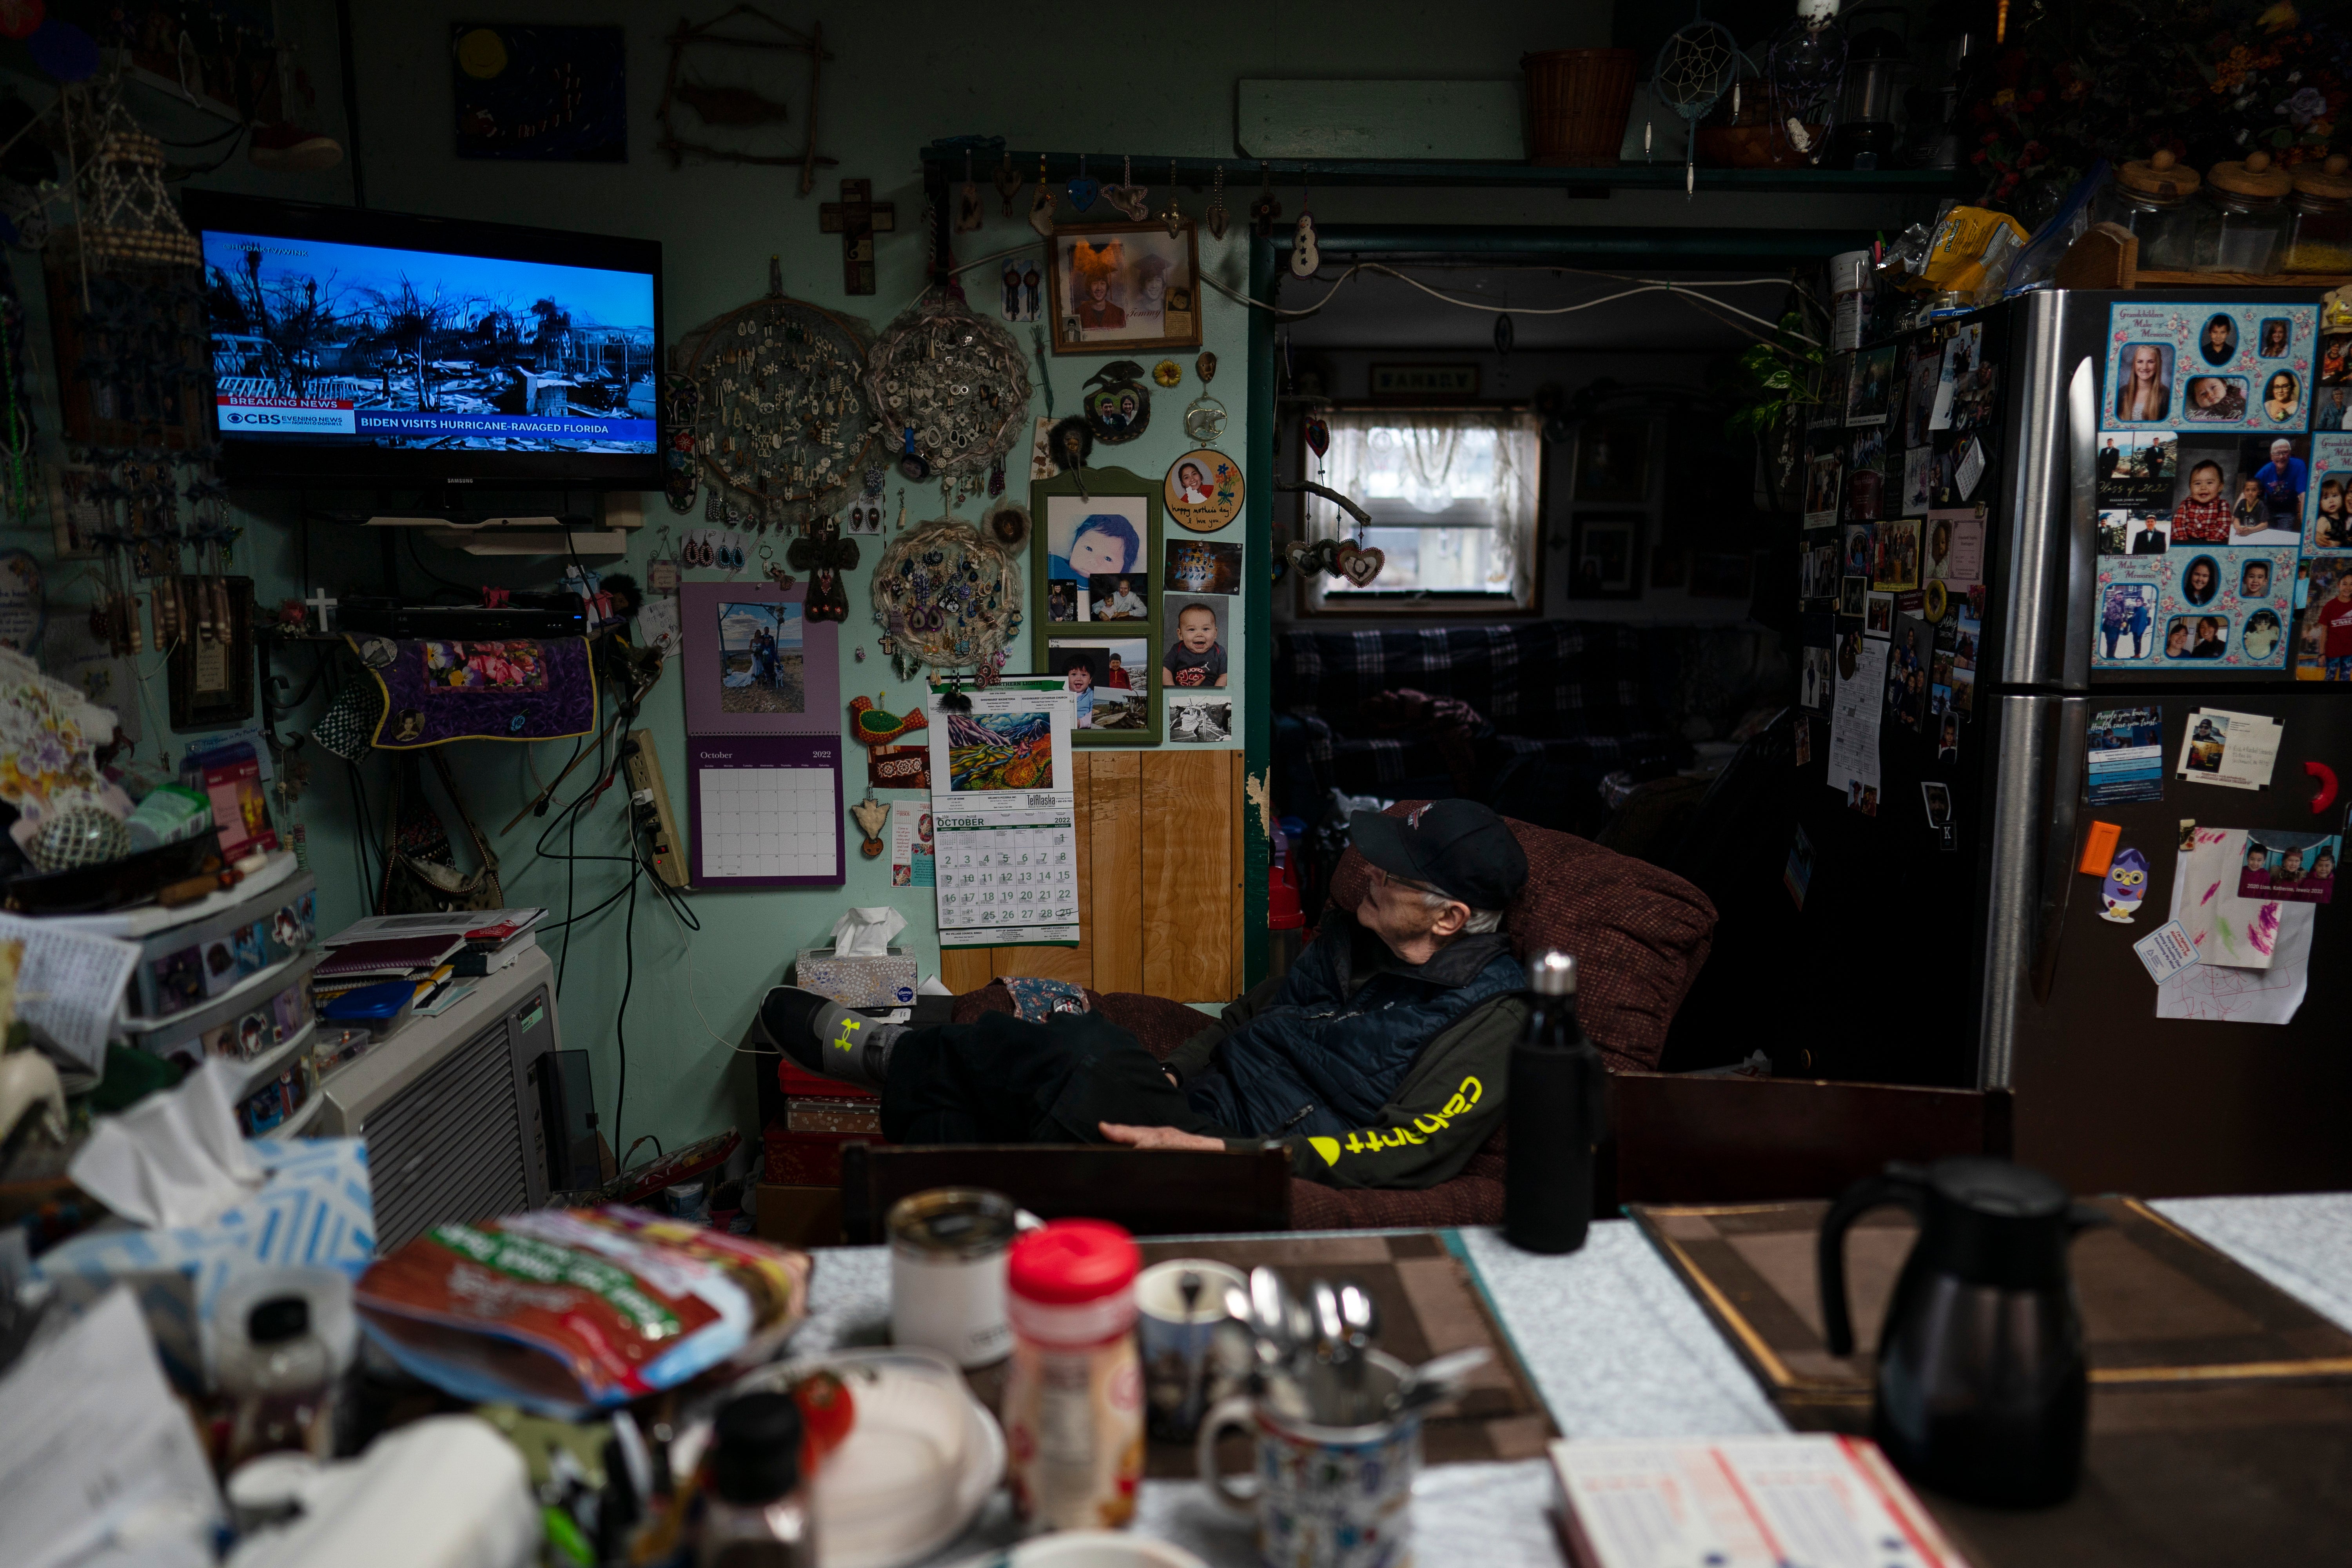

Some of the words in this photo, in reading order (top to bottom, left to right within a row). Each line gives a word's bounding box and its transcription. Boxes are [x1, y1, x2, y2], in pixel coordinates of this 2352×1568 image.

[1127, 308, 1161, 319] Tommy
[2120, 309, 2163, 319] Grandchildren
[2133, 319, 2152, 327] Make
[2141, 329, 2172, 337] Memories
[230, 398, 297, 406] BREAKING
[301, 400, 338, 408] NEWS
[244, 414, 281, 425] CBS
[361, 417, 398, 428] BIDEN
[401, 419, 437, 428] VISITS
[440, 420, 561, 432] HURRICANE-RAVAGED
[564, 424, 608, 433] FLORIDA
[2099, 481, 2123, 494] Class
[2127, 486, 2135, 497] of
[2138, 484, 2169, 493] 2022
[1172, 504, 1190, 517] happy
[1220, 507, 1232, 517] day!
[1208, 519, 1221, 528] you.
[2118, 561, 2136, 569] Make
[2096, 710, 2117, 720] People
[2091, 721, 2111, 731] Health
[2127, 722, 2139, 731] you
[2141, 717, 2158, 727] trust.
[243, 727, 258, 735] Pocket
[1027, 794, 1055, 806] TelAlaska
[1944, 827, 1951, 838] K
[1003, 854, 1008, 862] 5
[2154, 937, 2166, 955] Exercising
[2158, 933, 2166, 945] Eating
[2167, 946, 2176, 960] Healthy
[2166, 935, 2175, 948] Staying
[2170, 931, 2184, 951] Alzheimer's
[2180, 937, 2190, 952] fighting
